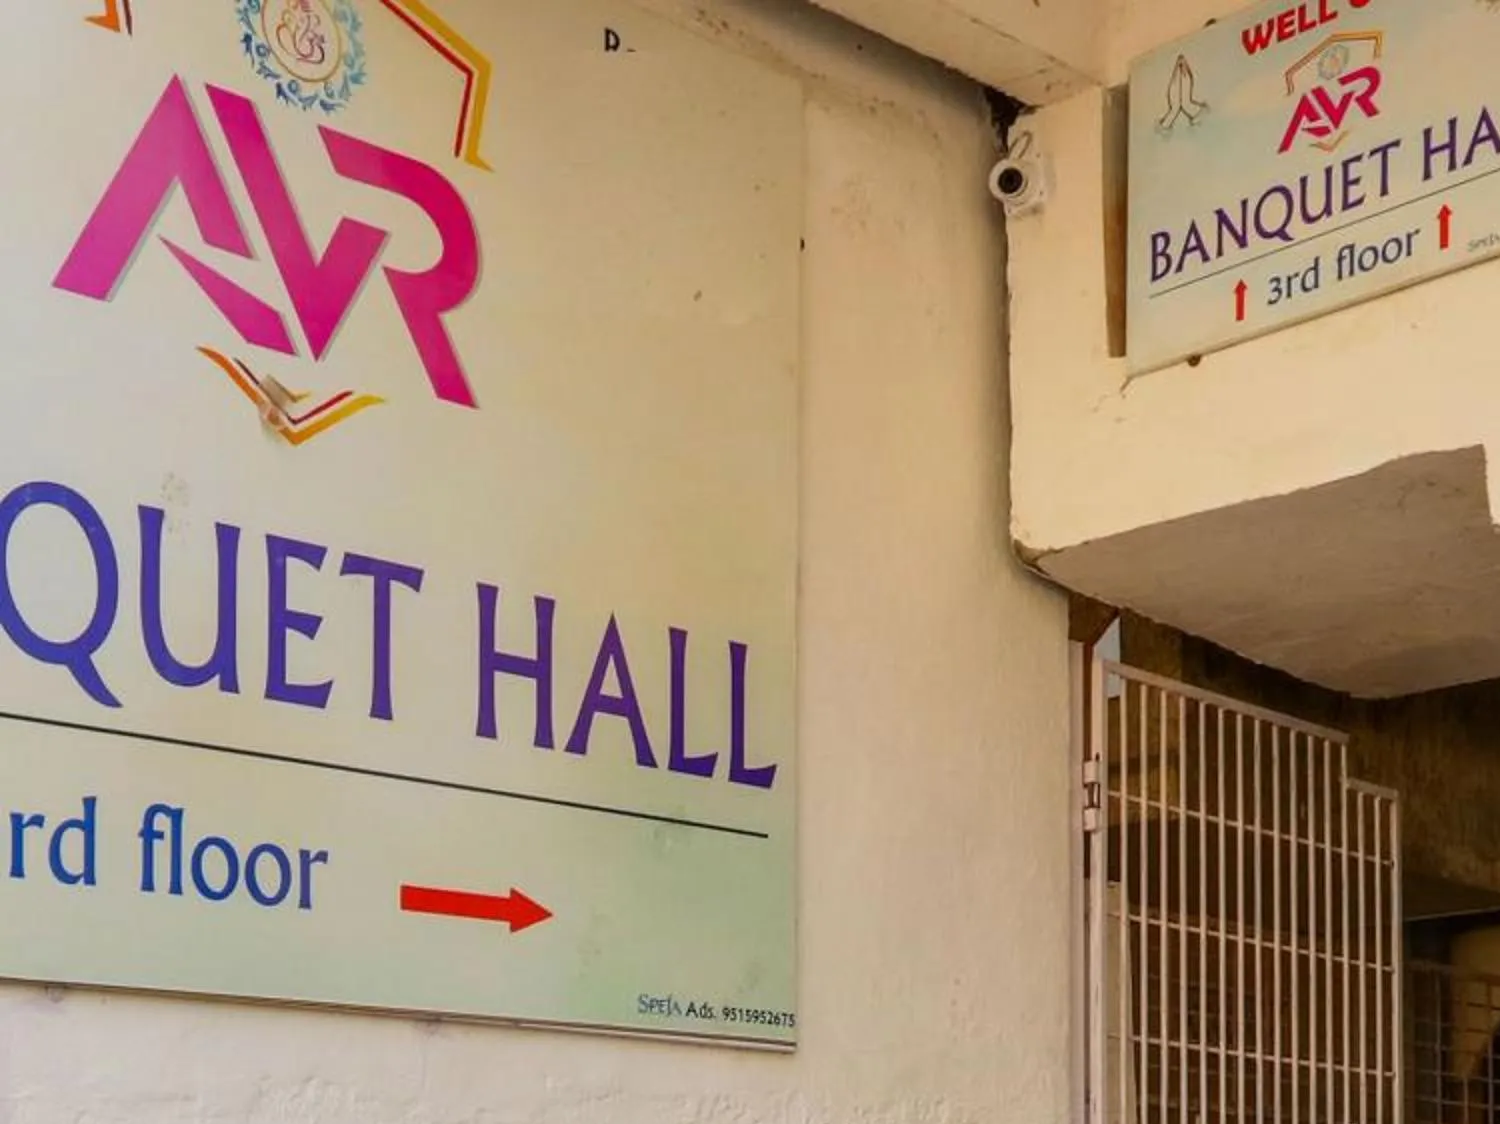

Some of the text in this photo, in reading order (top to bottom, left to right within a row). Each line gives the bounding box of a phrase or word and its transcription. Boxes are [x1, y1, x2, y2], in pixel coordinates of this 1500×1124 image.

[1241, 0, 1338, 56] WELL
[1278, 65, 1382, 154] AVR
[52, 73, 479, 408] AVR
[1150, 138, 1403, 284] BANQUET
[1266, 228, 1421, 306] 3rd floor
[474, 581, 778, 790] HALL
[9, 796, 329, 910] rd floor
